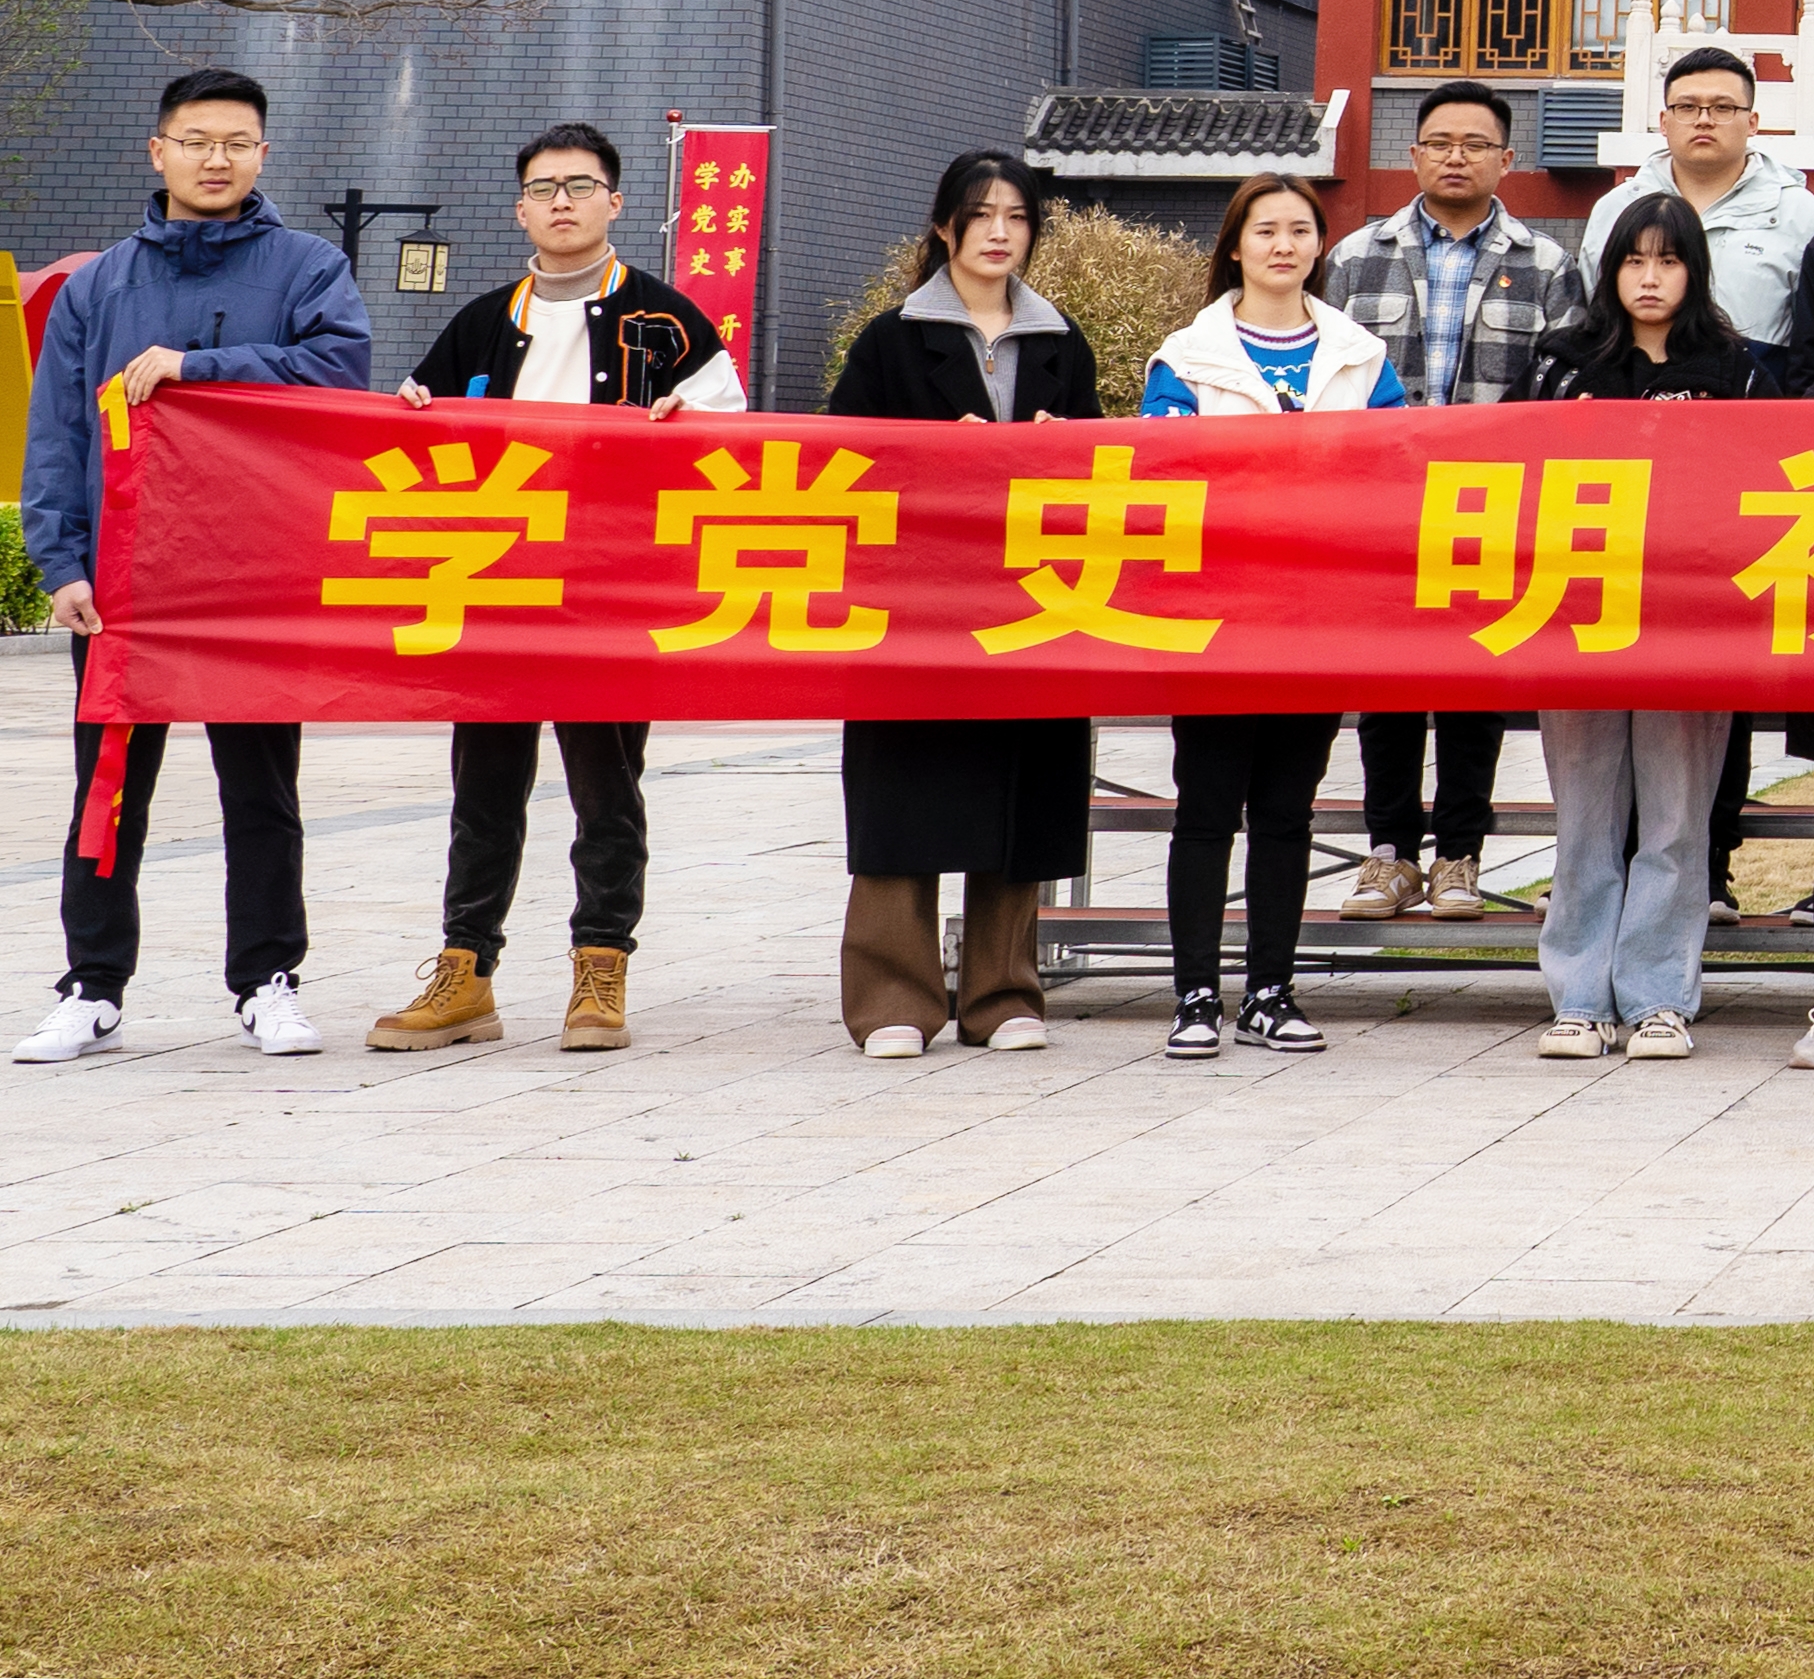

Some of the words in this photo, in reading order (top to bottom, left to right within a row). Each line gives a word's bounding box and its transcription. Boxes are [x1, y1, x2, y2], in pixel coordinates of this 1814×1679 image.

[688, 160, 721, 277] 学党史
[723, 162, 756, 278] 办实事
[321, 440, 1224, 656] 学党史
